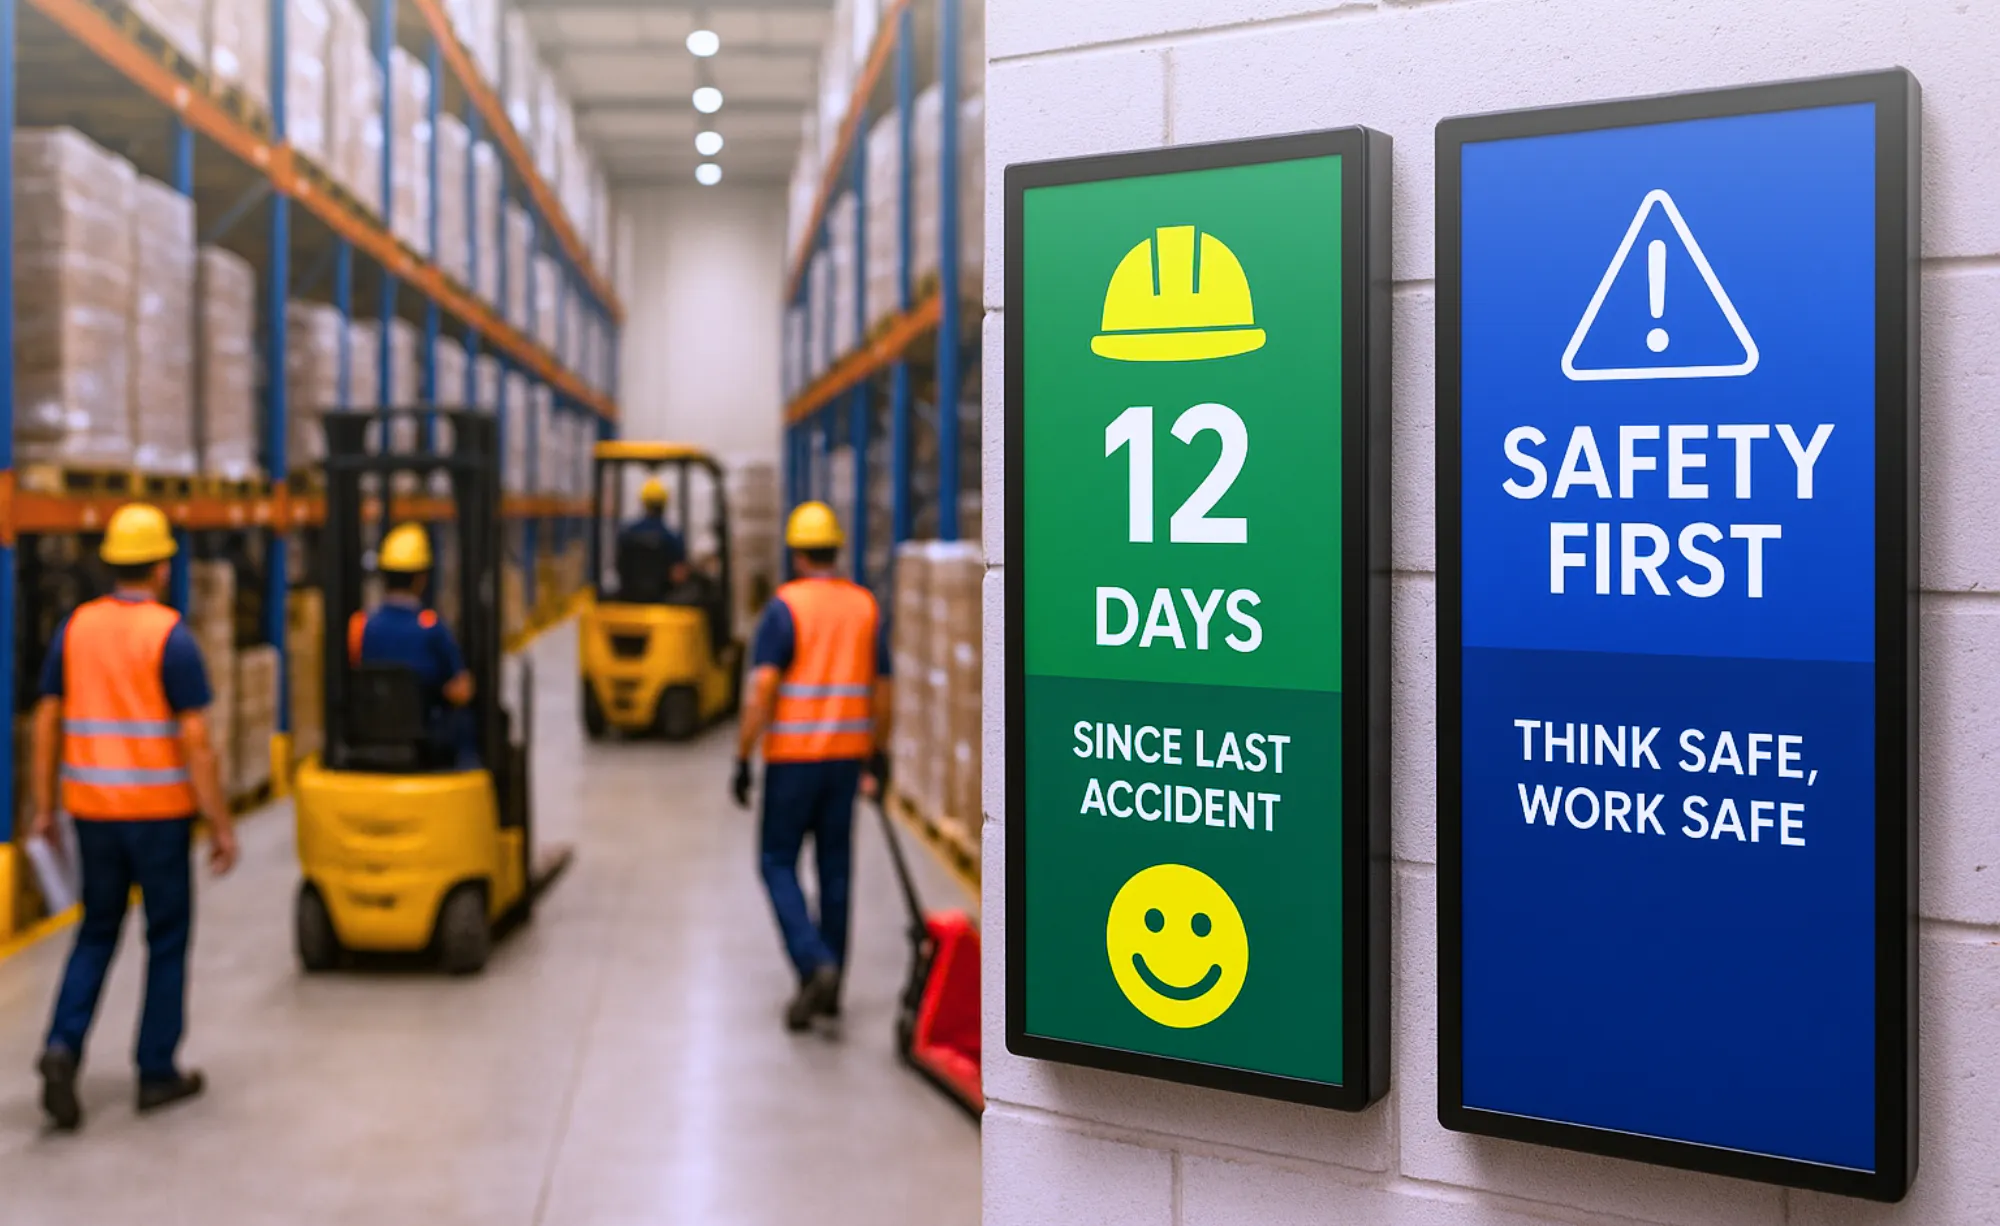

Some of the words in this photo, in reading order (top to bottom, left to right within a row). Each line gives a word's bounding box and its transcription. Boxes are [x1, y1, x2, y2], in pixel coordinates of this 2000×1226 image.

[1105, 403, 1248, 544] 12
[1502, 423, 1835, 500] SAFETY
[1549, 522, 1782, 598] FIRST
[1096, 586, 1263, 653] DAYS
[1073, 720, 1182, 765] SINCE
[1196, 729, 1291, 774] LAST
[1514, 719, 1661, 770] THINK
[1678, 728, 1819, 786] SAFE,
[1080, 778, 1281, 832] ACCIDENT
[1517, 783, 1666, 835] WORK
[1681, 795, 1806, 846] SAFE
